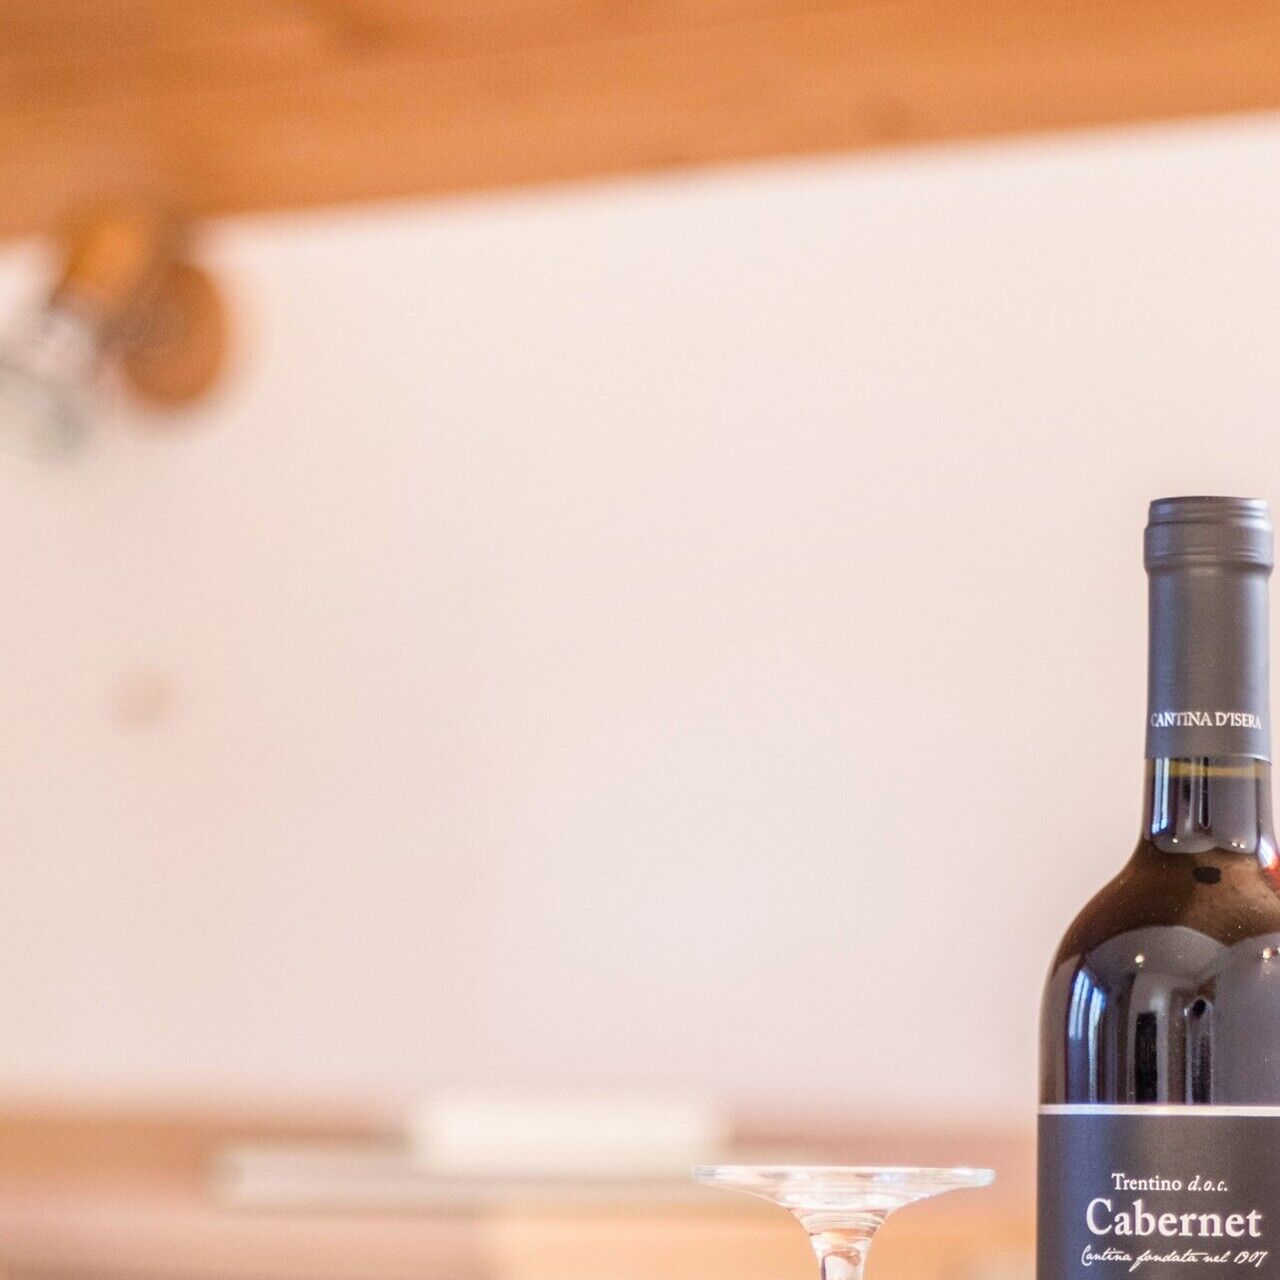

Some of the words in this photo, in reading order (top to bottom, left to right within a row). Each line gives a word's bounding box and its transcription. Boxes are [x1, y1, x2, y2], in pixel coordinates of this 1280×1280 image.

[1151, 711, 1212, 728] CANTINA
[1214, 711, 1262, 730] D'ISERA
[1111, 1172, 1182, 1192] Trentino
[1188, 1175, 1228, 1192] d.o.c.
[1086, 1198, 1262, 1237] Cabernet
[1081, 1244, 1132, 1267] Cantina
[1129, 1249, 1198, 1272] fondata
[1203, 1251, 1228, 1264] nel
[1234, 1251, 1268, 1268] 1907
